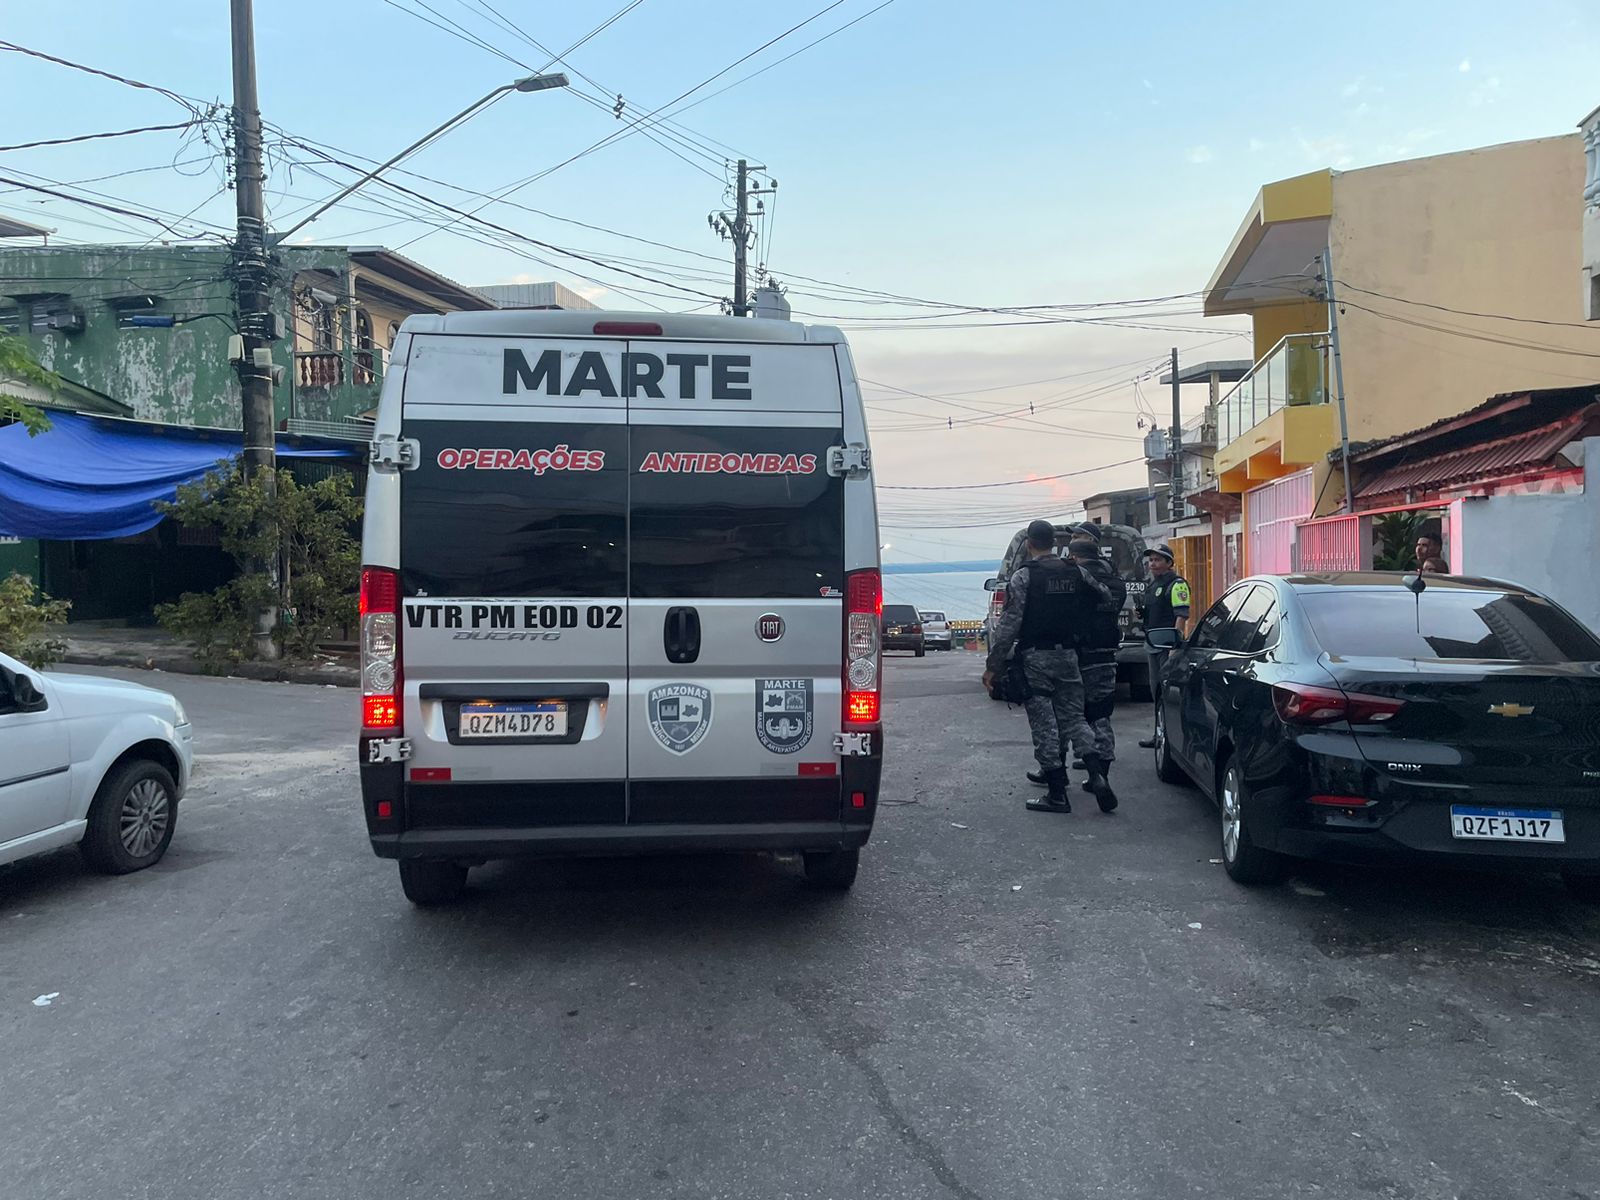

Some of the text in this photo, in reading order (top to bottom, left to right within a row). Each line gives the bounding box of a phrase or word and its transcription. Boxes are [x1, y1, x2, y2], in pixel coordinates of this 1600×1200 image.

[503, 349, 752, 400] MARTE
[437, 445, 817, 475] OPERAÇÕES ANTIBOMBAS
[1125, 582, 1145, 592] 9230
[406, 605, 623, 629] VTR PM EOD 02
[452, 630, 561, 641] DUCATO
[762, 621, 779, 635] FIAT
[764, 680, 806, 689] MARTE
[652, 686, 708, 701] AMAZONAS
[469, 714, 555, 734] QZM4D78
[1387, 762, 1422, 772] ONIX
[1462, 816, 1551, 838] QZF1J17
